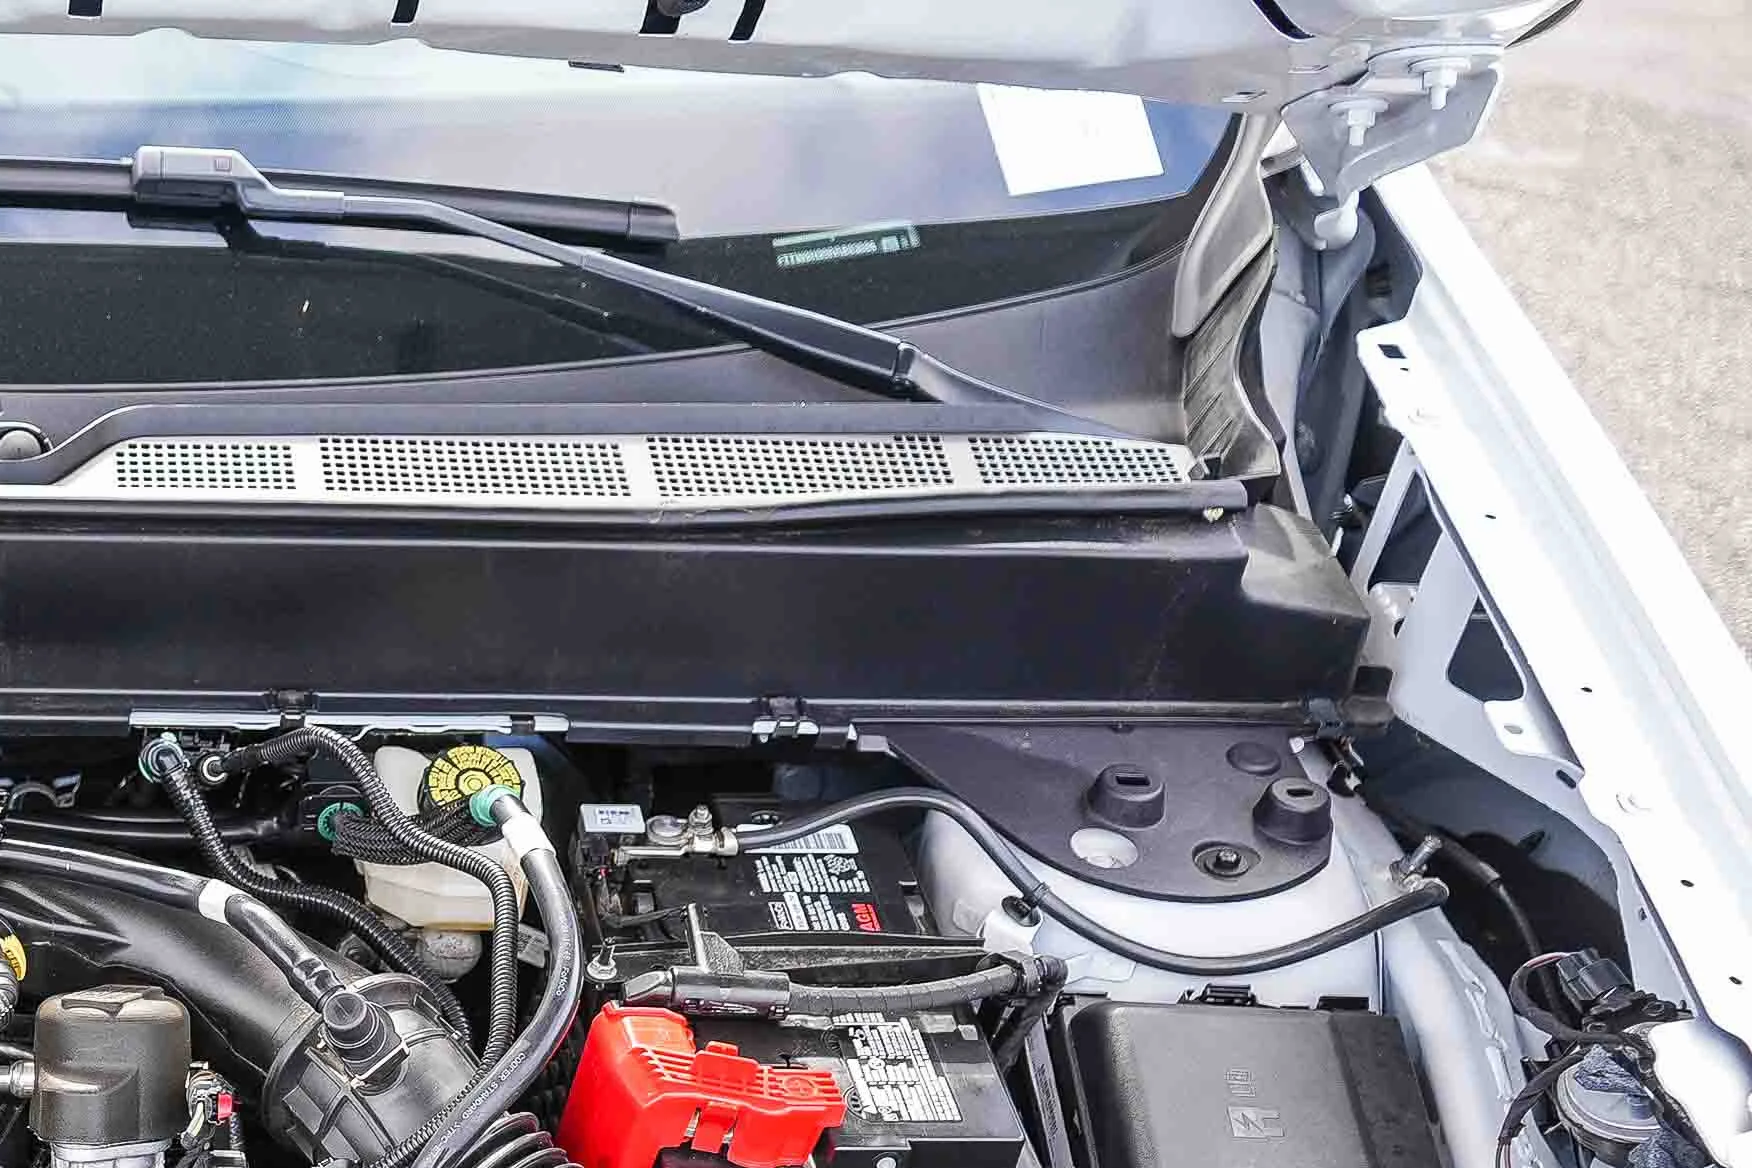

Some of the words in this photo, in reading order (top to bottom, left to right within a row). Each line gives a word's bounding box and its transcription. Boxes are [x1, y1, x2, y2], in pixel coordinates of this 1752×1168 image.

[852, 903, 875, 931] AGM
[555, 966, 570, 997] FoMoCo
[461, 1080, 499, 1120] STANDARD
